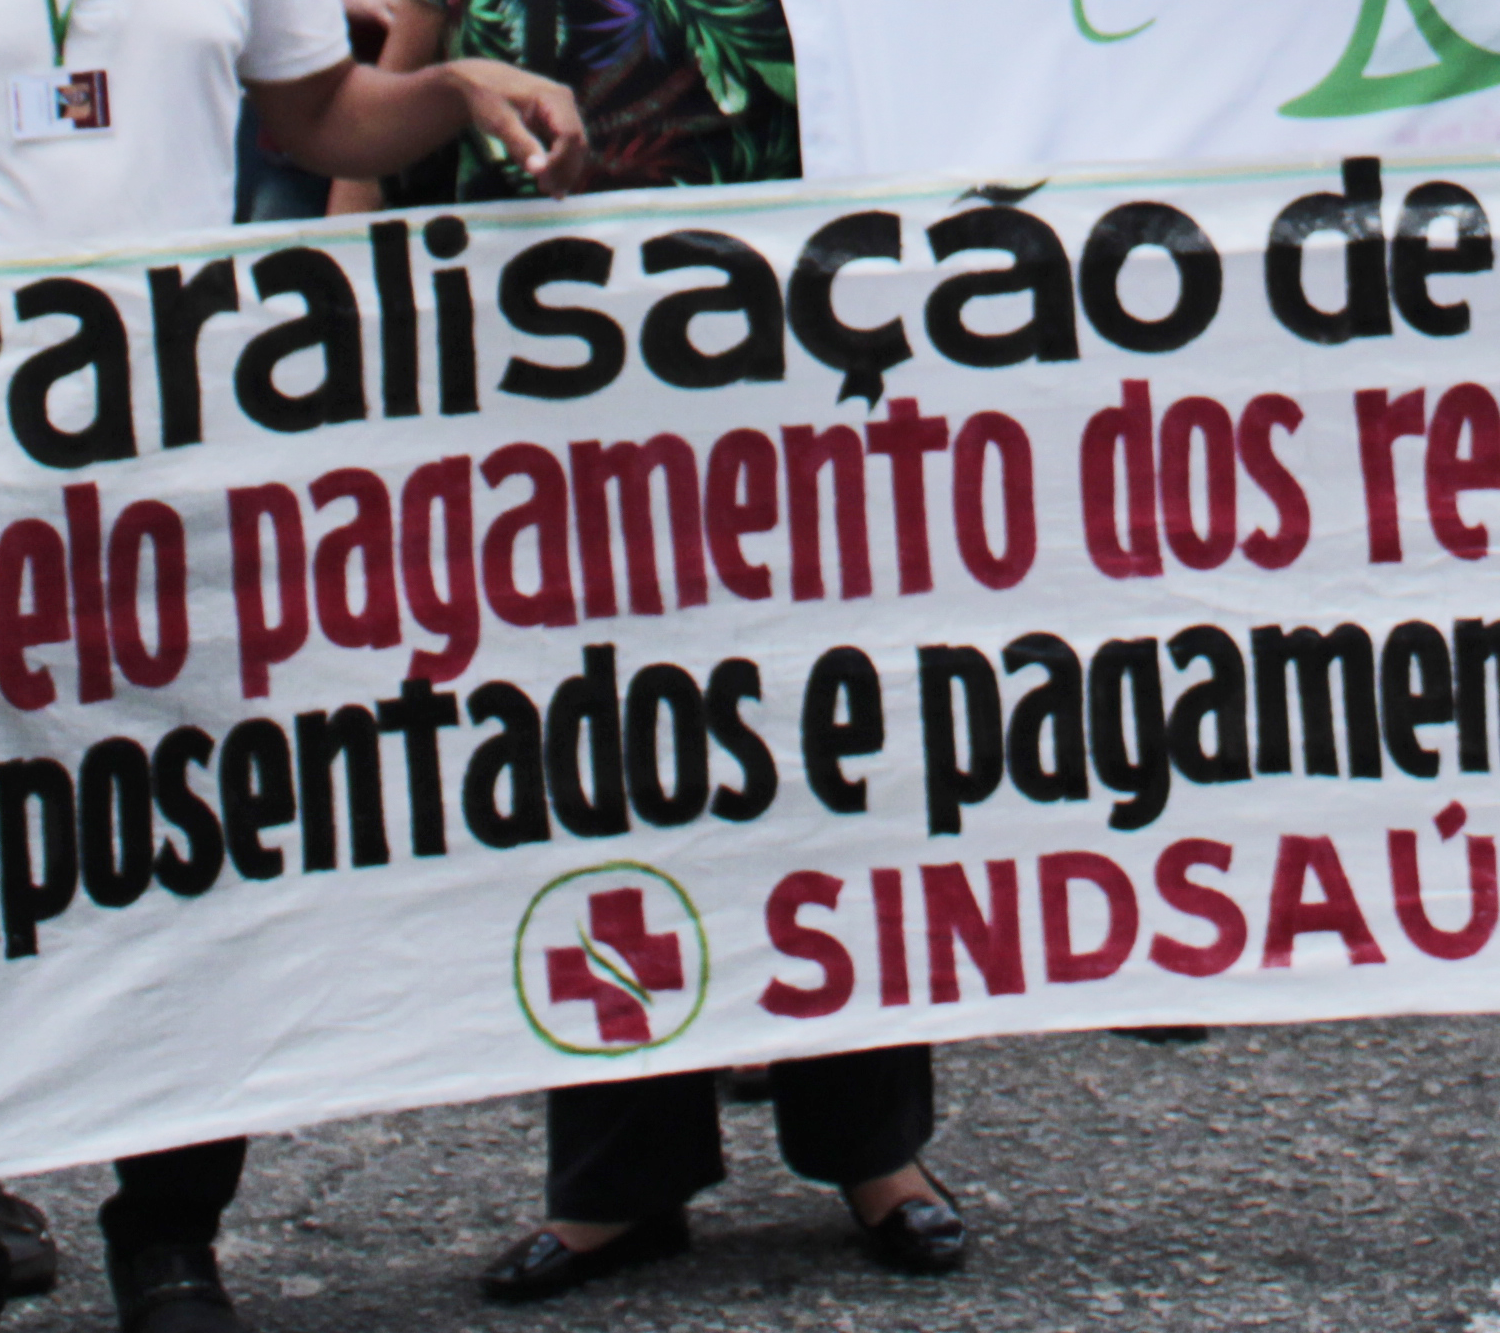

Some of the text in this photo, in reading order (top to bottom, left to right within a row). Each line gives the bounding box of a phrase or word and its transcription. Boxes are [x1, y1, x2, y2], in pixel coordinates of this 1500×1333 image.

[1265, 158, 1494, 344] de
[227, 399, 1037, 699] pagamento
[1080, 379, 1311, 581] dos
[801, 645, 885, 814] e
